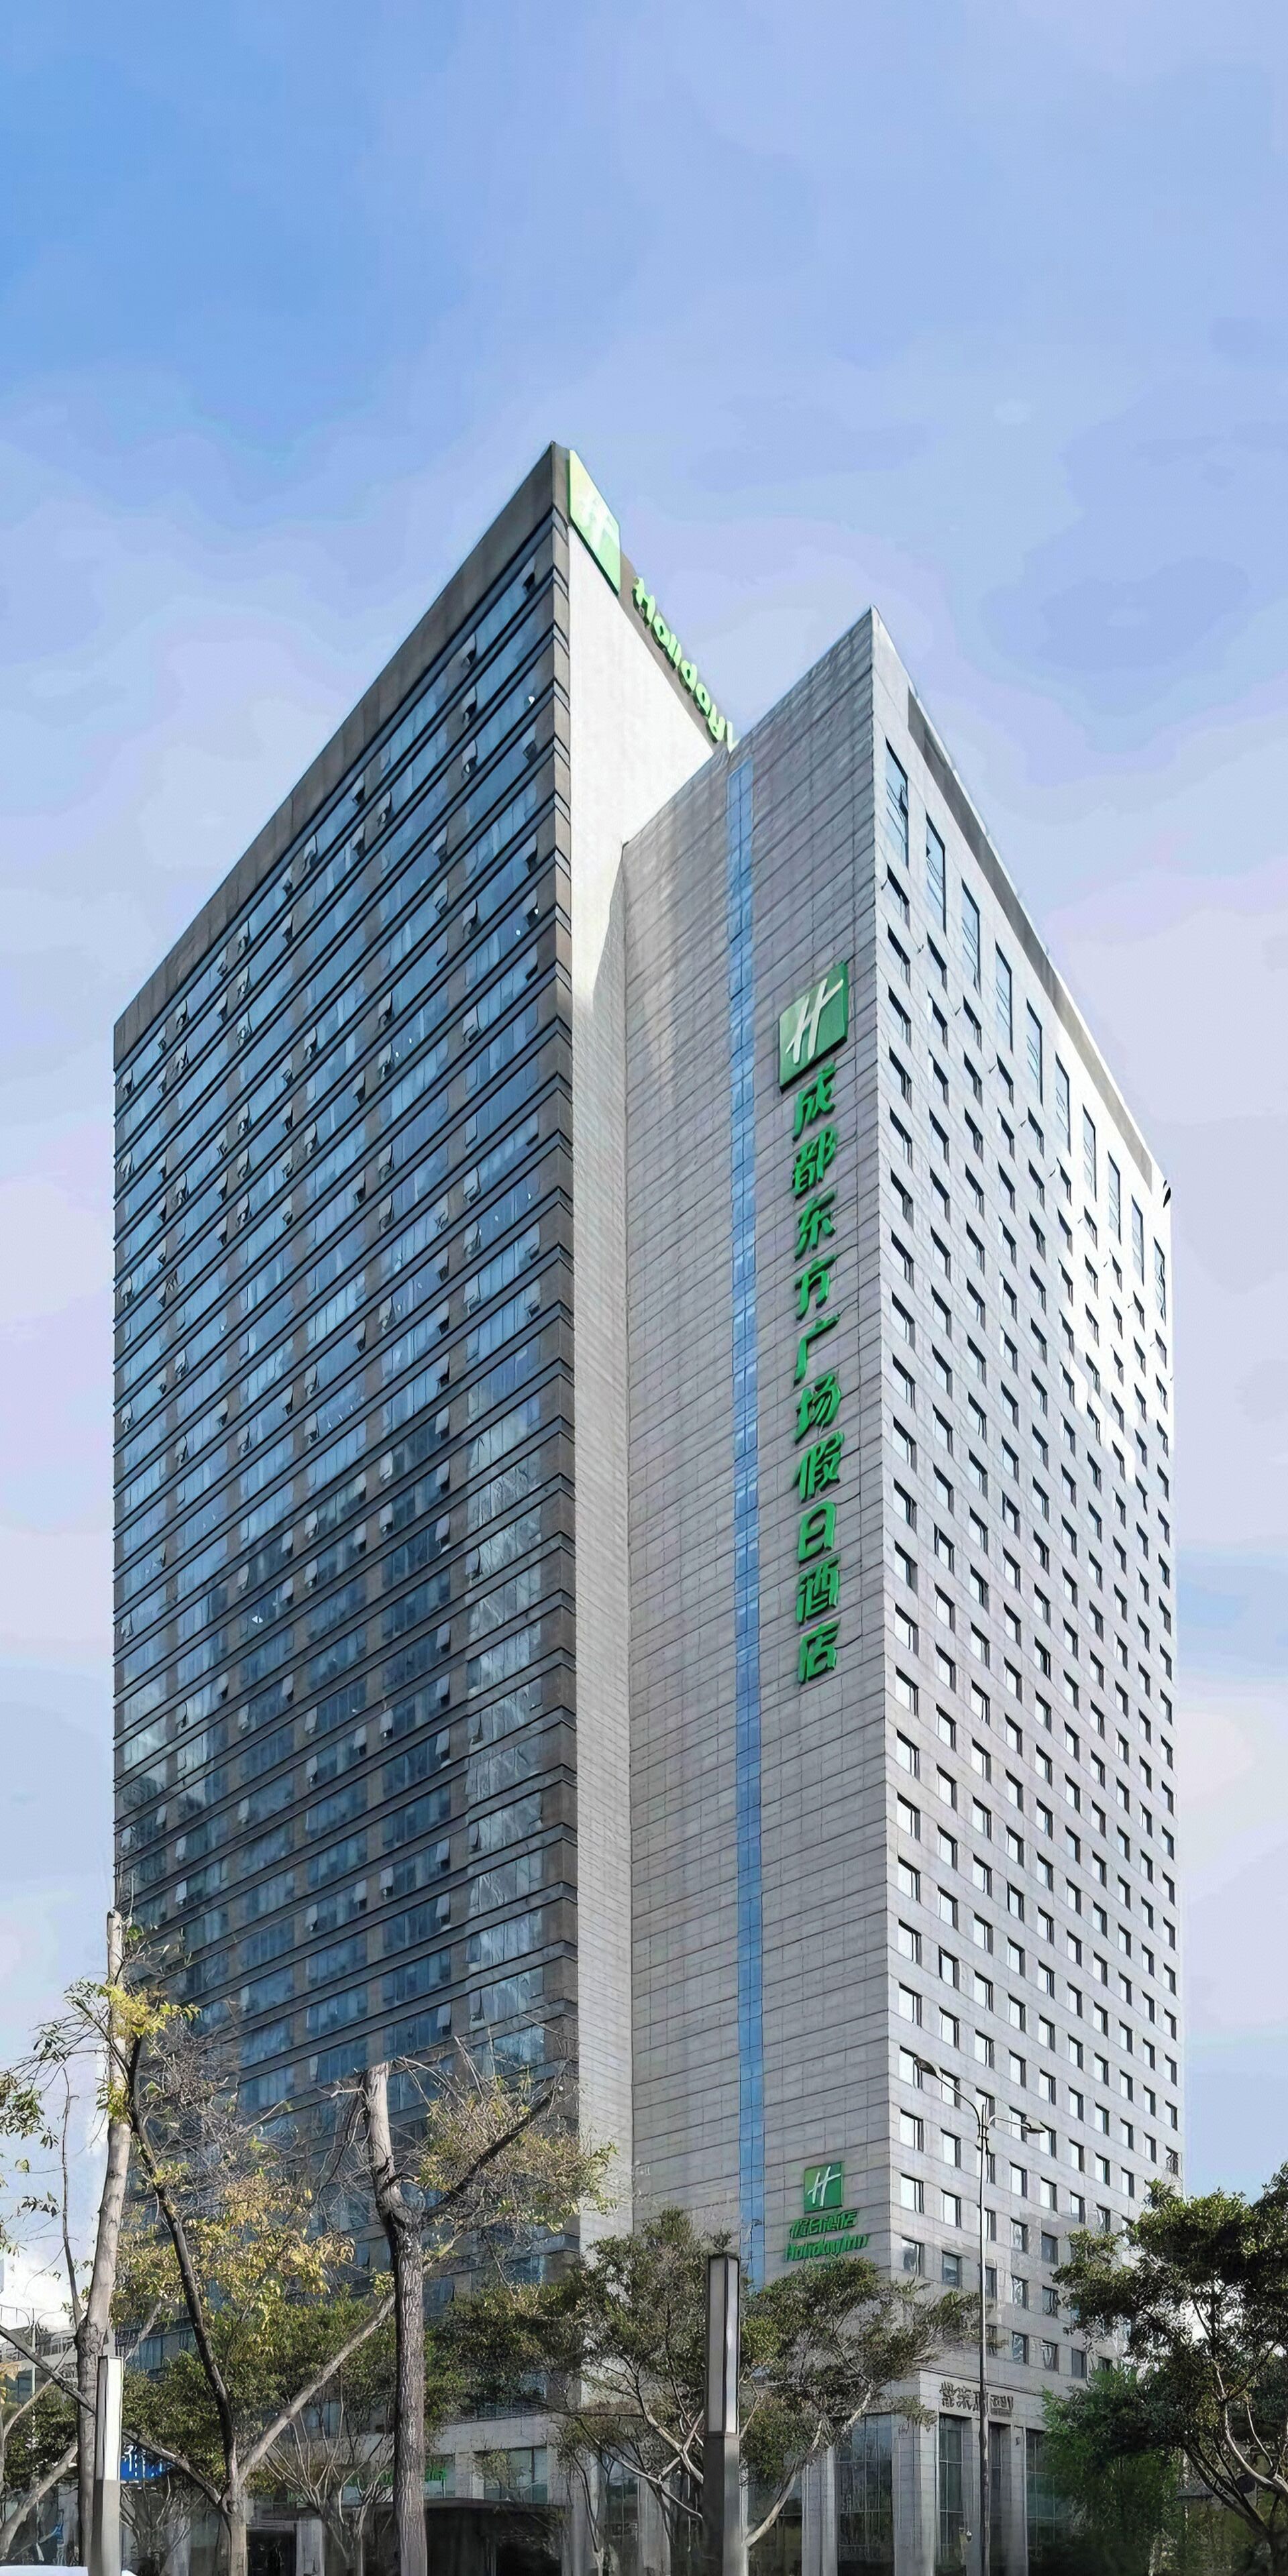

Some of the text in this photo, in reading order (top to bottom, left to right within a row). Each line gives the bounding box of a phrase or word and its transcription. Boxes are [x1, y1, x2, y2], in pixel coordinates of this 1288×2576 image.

[632, 576, 726, 743] Holiday
[792, 1062, 844, 1684] 成都东方广场假日酒店
